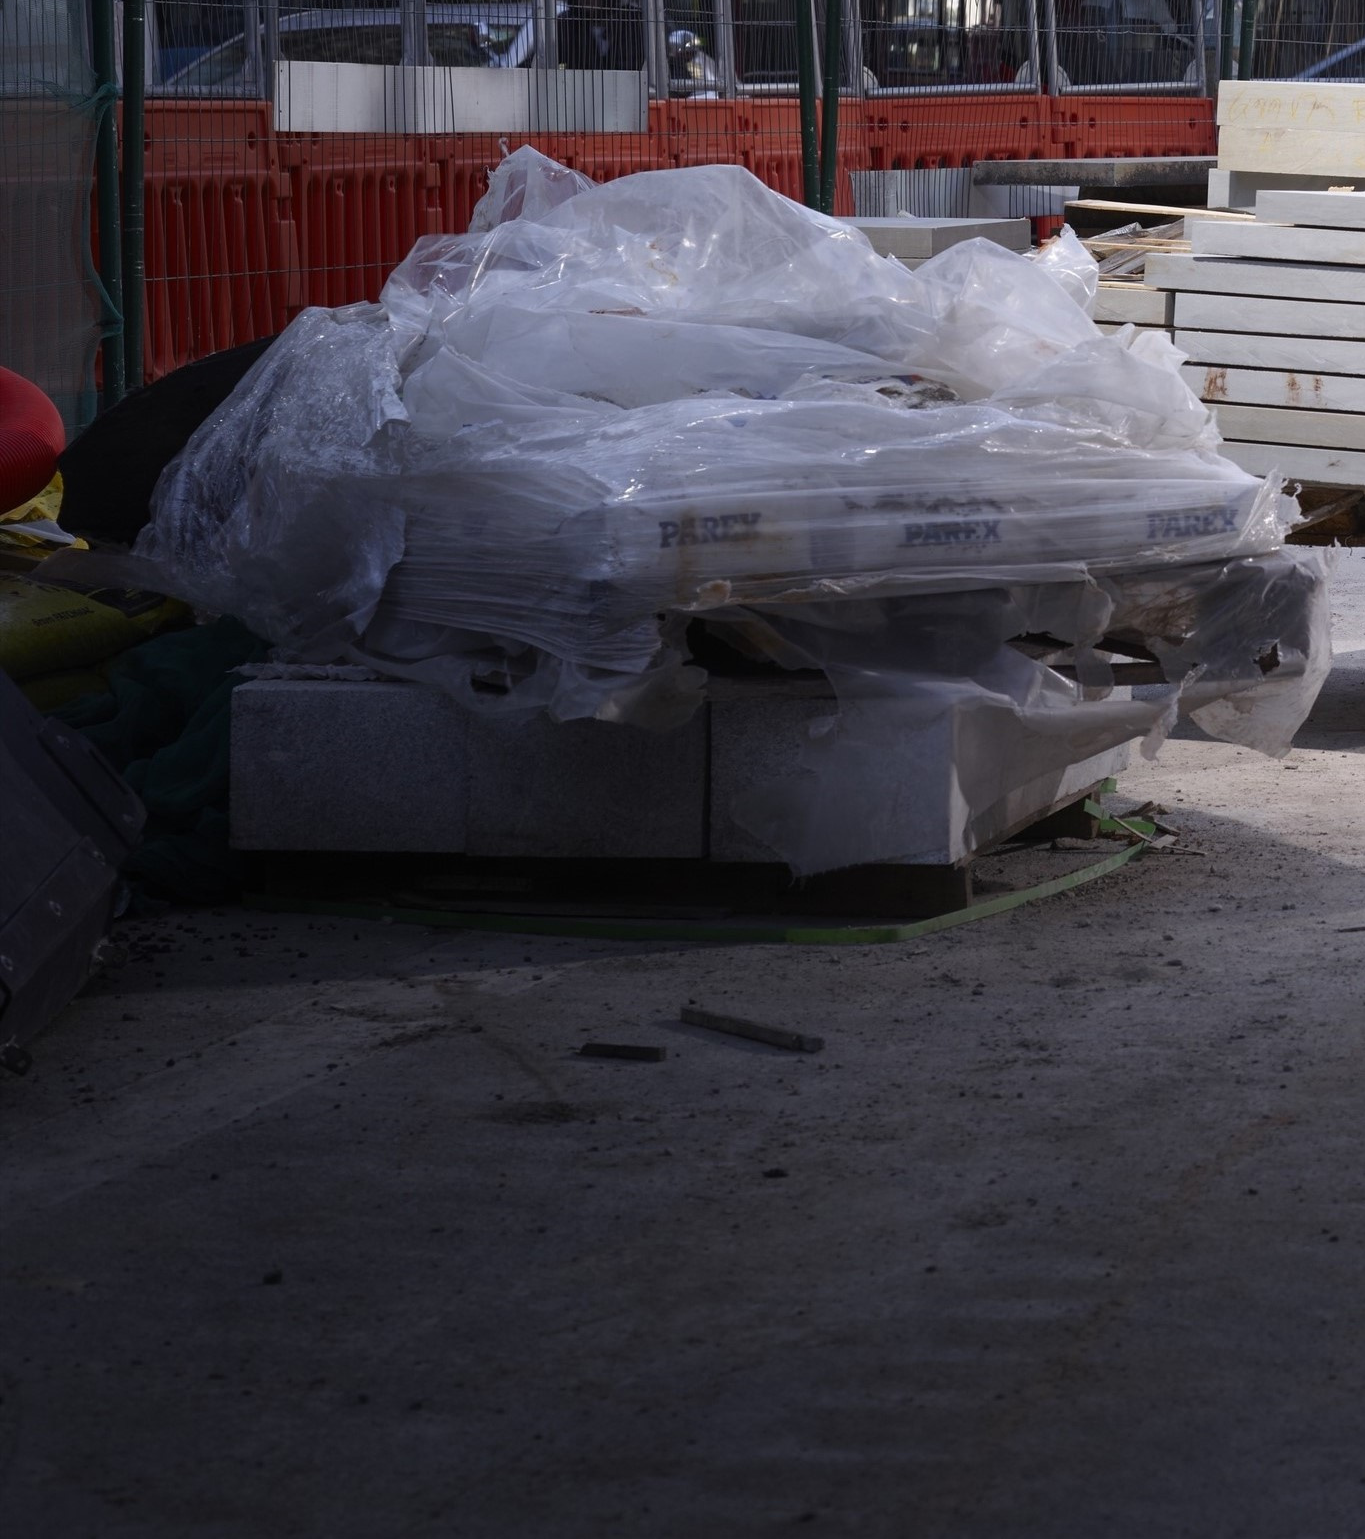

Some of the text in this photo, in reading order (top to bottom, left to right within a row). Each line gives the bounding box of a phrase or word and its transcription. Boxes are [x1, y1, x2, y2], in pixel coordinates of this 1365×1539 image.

[658, 512, 761, 548] PAREX
[904, 519, 1001, 545] PAREX
[1146, 508, 1240, 540] PAREX
